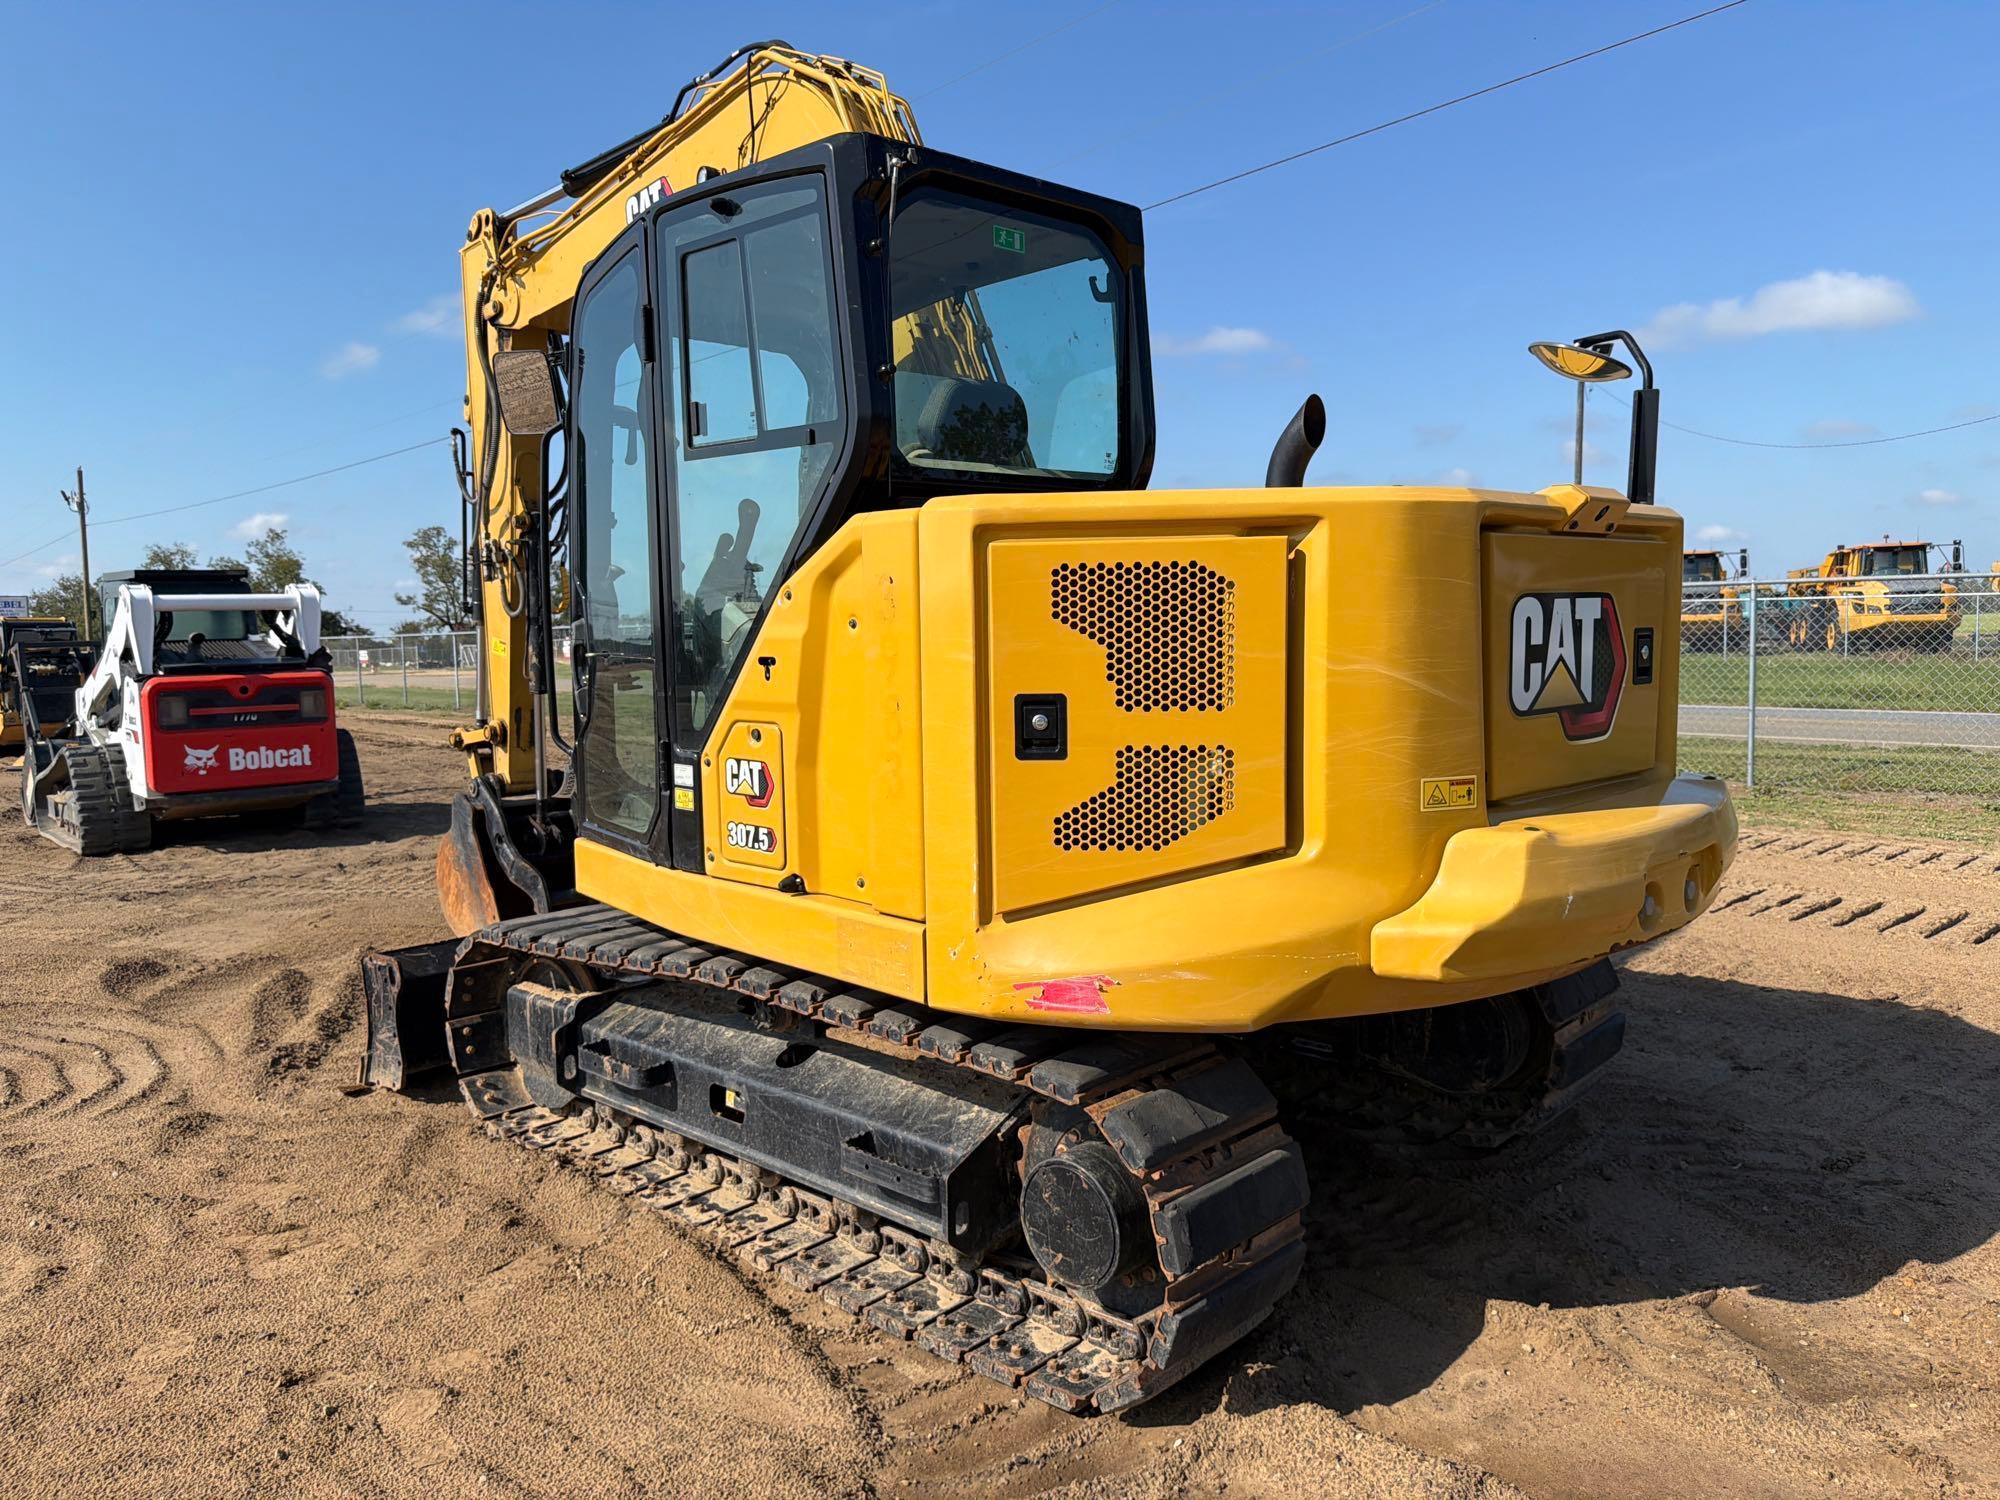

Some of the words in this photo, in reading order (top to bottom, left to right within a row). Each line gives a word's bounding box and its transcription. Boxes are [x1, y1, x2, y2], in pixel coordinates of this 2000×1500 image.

[626, 179, 662, 225] CAT
[1511, 596, 1603, 712] CAT
[228, 744, 312, 772] Bobcat
[726, 758, 762, 797] CAT
[727, 821, 769, 851] 307.5
